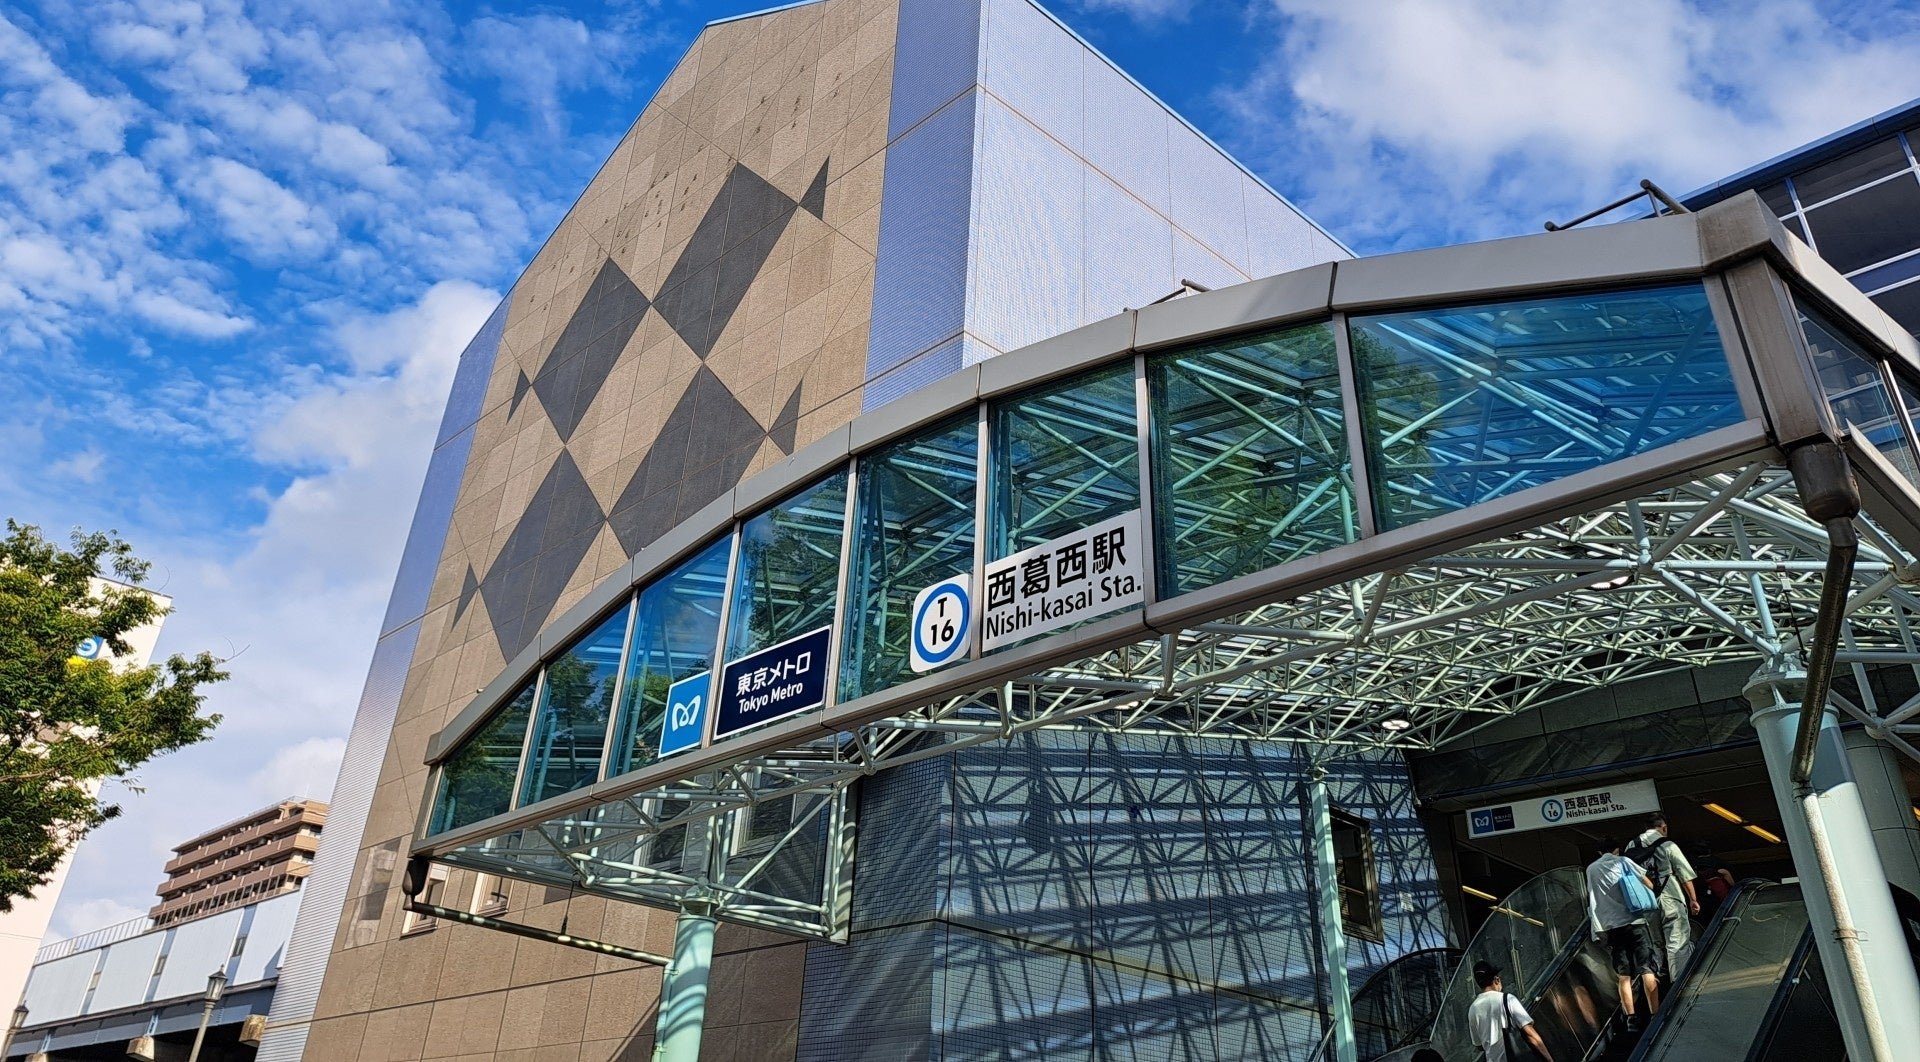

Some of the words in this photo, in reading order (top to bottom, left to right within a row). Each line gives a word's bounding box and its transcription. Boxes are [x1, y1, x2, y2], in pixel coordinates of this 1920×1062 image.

[987, 526, 1127, 612] 西葛西駅
[937, 596, 948, 618] T
[986, 581, 1093, 640] Nishi-kasai
[1101, 574, 1142, 602] Sta.
[930, 618, 955, 646] 16
[735, 651, 811, 697] 東京メトロ
[738, 694, 769, 714] Tokyo
[770, 682, 803, 704] Metro
[1564, 792, 1612, 810] 西葛西駅
[1566, 804, 1609, 818] Nishi-kasai
[1611, 803, 1627, 811] Sta.
